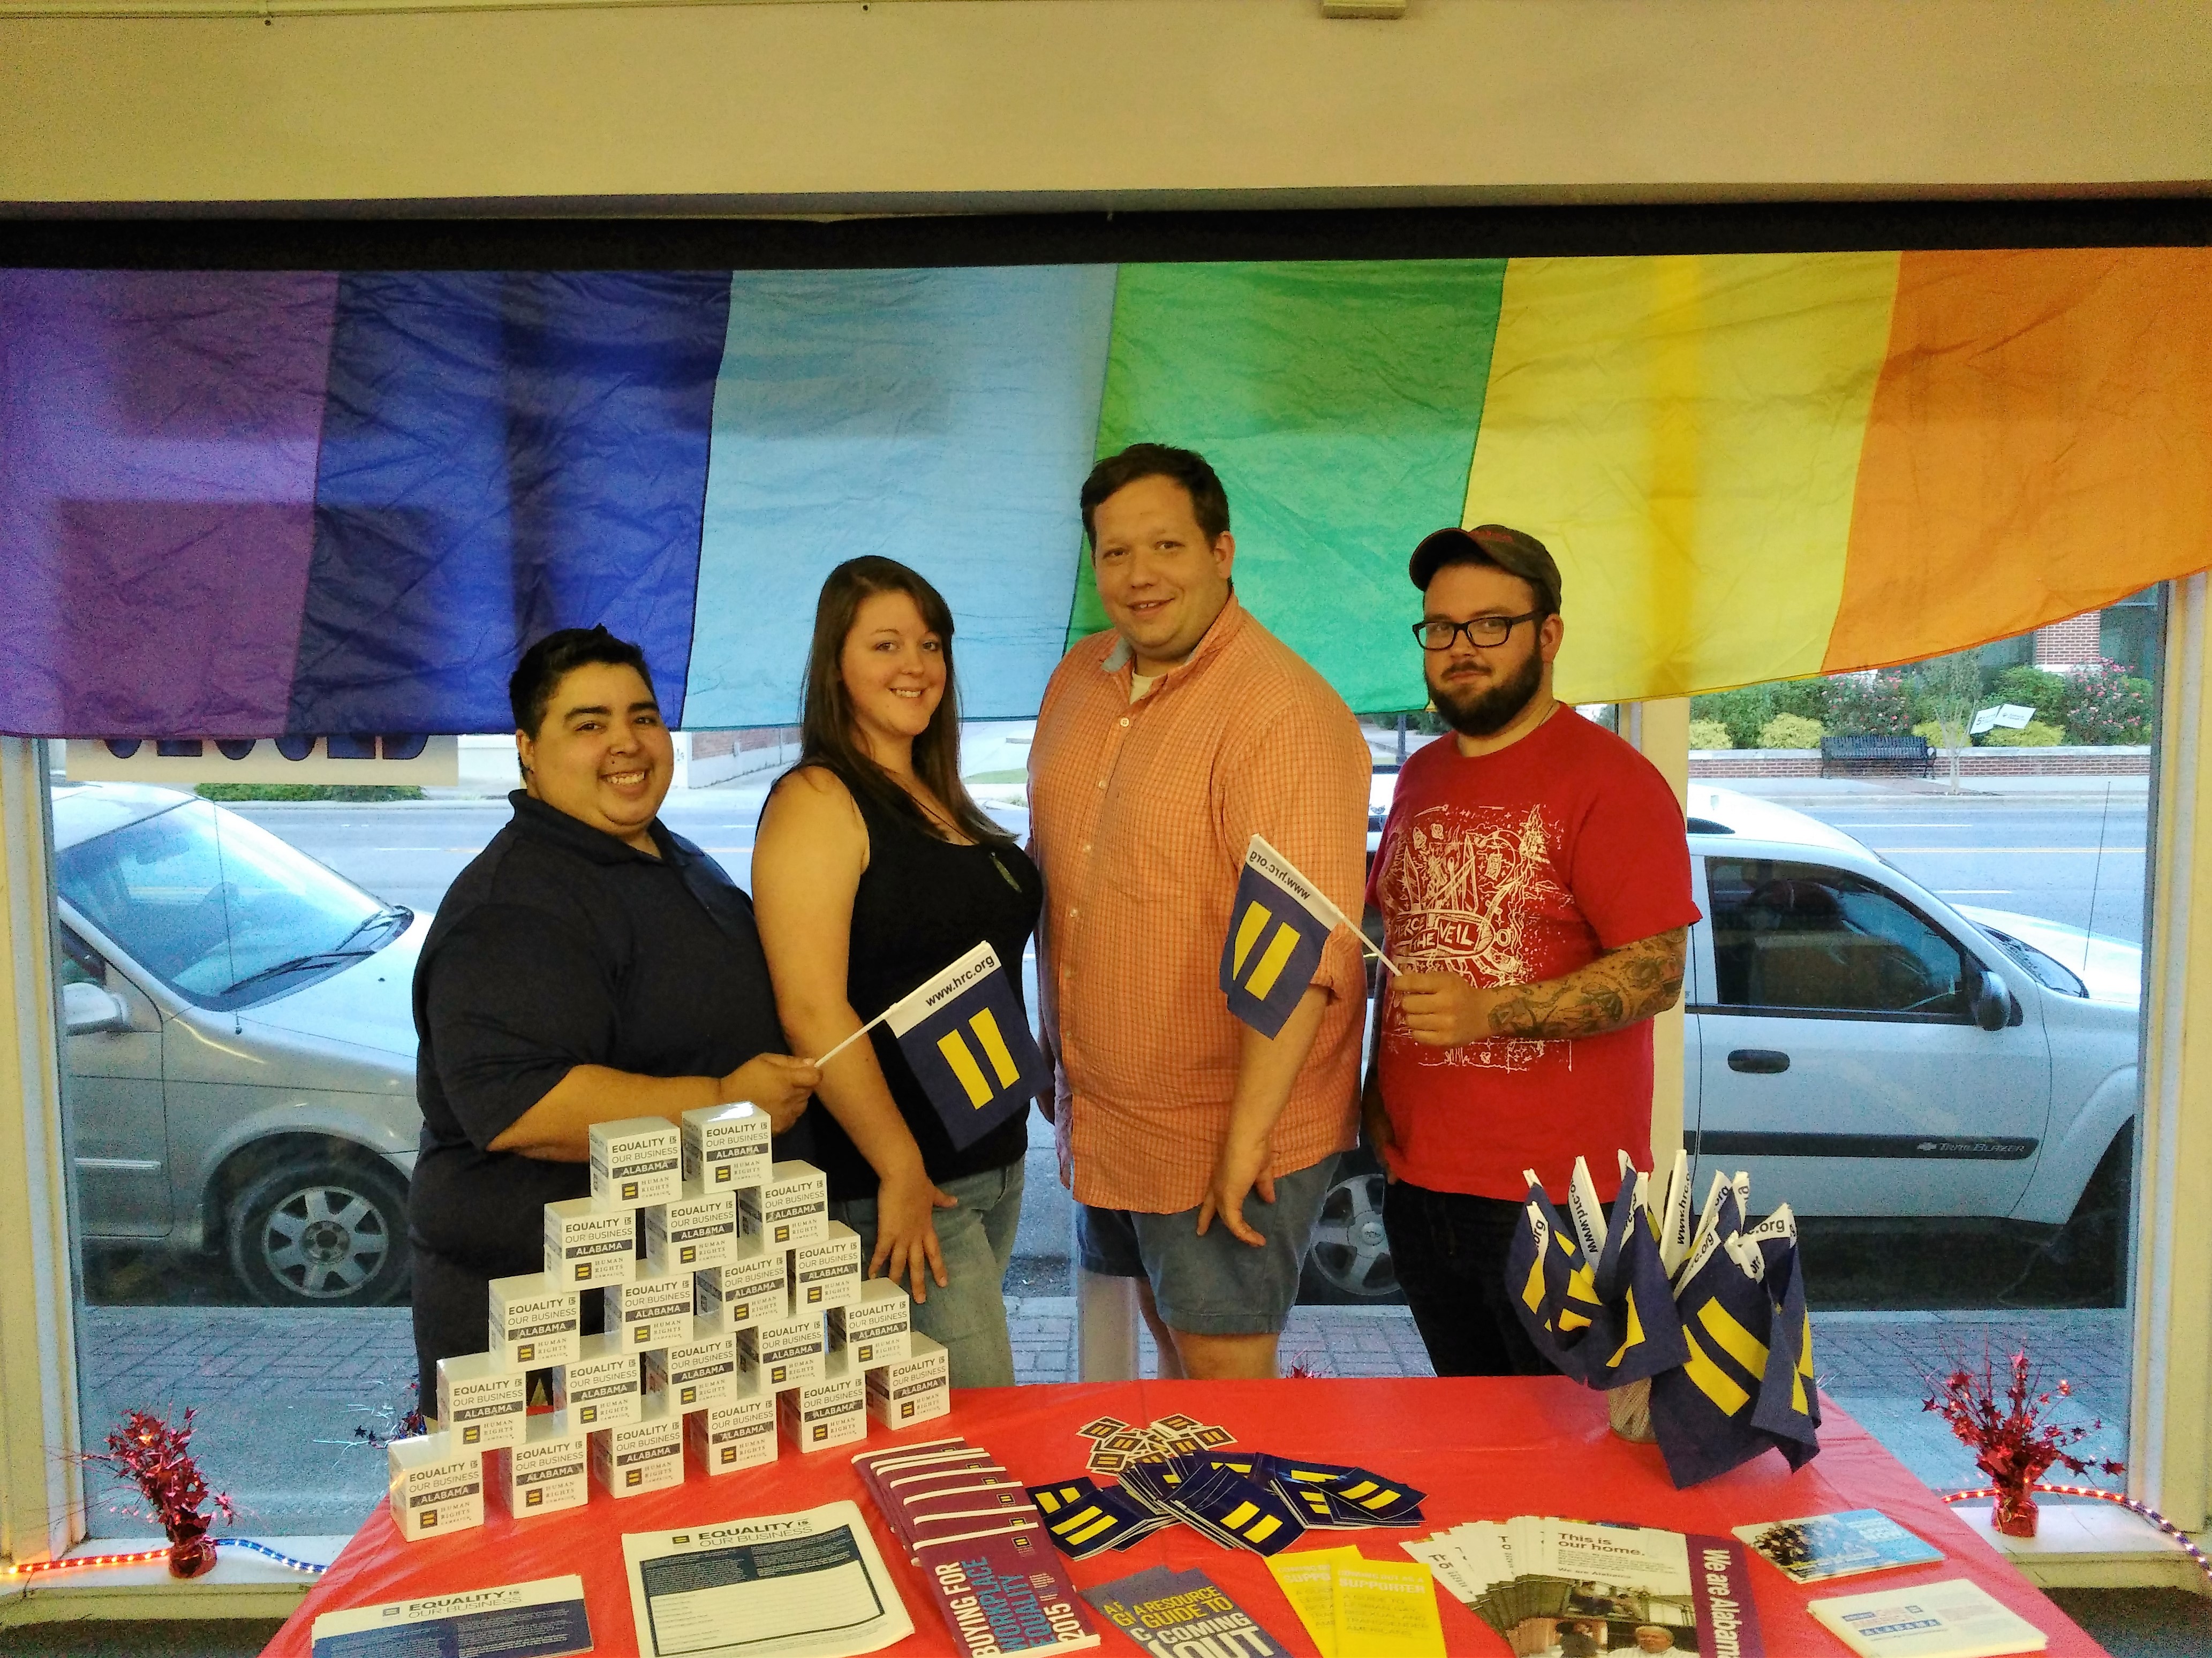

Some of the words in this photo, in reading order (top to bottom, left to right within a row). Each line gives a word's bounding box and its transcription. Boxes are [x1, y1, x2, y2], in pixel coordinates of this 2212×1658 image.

[1413, 932, 1435, 950] THE
[1440, 921, 1474, 945] VEIL
[925, 956, 994, 1006] www.hrc.org
[706, 1123, 756, 1137] EQUALITY
[760, 1121, 767, 1130] IS
[612, 1137, 665, 1153] EQUALITY
[669, 1135, 677, 1144] IS
[706, 1138, 724, 1147] OUR
[728, 1132, 768, 1144] BUSINESS
[611, 1154, 631, 1164] OUR
[635, 1146, 678, 1160] BUSINESS
[716, 1145, 759, 1159] ALABAMA
[622, 1161, 668, 1175] ALABAMA
[765, 1182, 812, 1199] EQUALITY
[765, 1198, 783, 1208] OUR
[786, 1190, 824, 1205] BUSINESS
[671, 1202, 721, 1218] EQUALITY
[726, 1200, 733, 1209] IS
[775, 1203, 816, 1219] ALABAMA
[565, 1217, 619, 1233] EQUALITY
[624, 1216, 631, 1225] IS
[670, 1218, 690, 1228] OUR
[692, 1210, 733, 1224] BUSINESS
[565, 1234, 585, 1244] OUR
[588, 1227, 632, 1240] BUSINESS
[681, 1224, 724, 1239] ALABAMA
[576, 1241, 623, 1255] ALABAMA
[799, 1243, 846, 1259] EQUALITY
[595, 1257, 623, 1266] HUMAN
[595, 1264, 623, 1273] RIGHTS
[724, 1259, 772, 1277] EQUALITY
[799, 1259, 817, 1269] OUR
[819, 1251, 858, 1265] BUSINESS
[724, 1277, 743, 1288] OUR
[745, 1266, 784, 1283] BUSINESS
[808, 1265, 849, 1280] ALABAMA
[625, 1281, 677, 1297] EQUALITY
[682, 1280, 689, 1288] IS
[735, 1281, 776, 1298] ALABAMA
[509, 1298, 563, 1315] EQUALITY
[568, 1296, 576, 1305] IS
[625, 1297, 644, 1307] OUR
[647, 1290, 690, 1304] BUSINESS
[508, 1315, 529, 1326] OUR
[532, 1307, 576, 1322] BUSINESS
[635, 1304, 681, 1319] ALABAMA
[849, 1303, 895, 1320] EQUALITY
[849, 1319, 866, 1329] OUR
[869, 1310, 907, 1325] BUSINESS
[519, 1322, 567, 1337] ALABAMA
[762, 1322, 810, 1339] EQUALITY
[858, 1324, 899, 1339] ALABAMA
[762, 1339, 780, 1350] OUR
[782, 1330, 821, 1345] BUSINESS
[671, 1342, 721, 1360] EQUALITY
[671, 1359, 690, 1370] OUR
[692, 1350, 733, 1365] BUSINESS
[772, 1344, 813, 1360] ALABAMA
[570, 1360, 623, 1378] EQUALITY
[681, 1364, 724, 1381] ALABAMA
[893, 1358, 935, 1377] EQUALITY
[893, 1376, 909, 1387] OUR
[911, 1365, 946, 1381] BUSINESS
[570, 1378, 590, 1388] OUR
[593, 1369, 637, 1384] BUSINESS
[901, 1379, 938, 1396] ALABAMA
[454, 1380, 509, 1396] EQUALITY
[581, 1383, 627, 1399] ALABAMA
[804, 1380, 851, 1399] EQUALITY
[453, 1397, 474, 1407] OUR
[477, 1389, 523, 1403] BUSINESS
[804, 1398, 821, 1409] OUR
[824, 1388, 863, 1404] BUSINESS
[464, 1403, 512, 1419] ALABAMA
[712, 1402, 761, 1420] EQUALITY
[813, 1402, 855, 1418] ALABAMA
[712, 1419, 730, 1430] OUR
[733, 1410, 773, 1425] BUSINESS
[616, 1423, 667, 1442] EQUALITY
[722, 1424, 765, 1440] ALABAMA
[616, 1441, 635, 1452] OUR
[638, 1432, 680, 1447] BUSINESS
[516, 1442, 570, 1461] EQUALITY
[626, 1446, 671, 1463] ALABAMA
[516, 1460, 536, 1471] OUR
[539, 1451, 583, 1466] BUSINESS
[409, 1462, 465, 1482] EQUALITY
[526, 1465, 573, 1482] ALABAMA
[409, 1481, 430, 1493] OUR
[433, 1470, 479, 1488] BUSINESS
[420, 1486, 469, 1504] ALABAMA
[699, 1521, 794, 1540] EQUALITY
[700, 1536, 734, 1547] OUR
[737, 1526, 812, 1542] BUSINESS
[1558, 1533, 1593, 1543] This
[1558, 1541, 1587, 1549] our
[1591, 1543, 1645, 1556] home.
[1703, 1549, 1732, 1572] We
[935, 1562, 971, 1596] FOR
[1339, 1578, 1425, 1594] SUPPORTER
[1705, 1573, 1731, 1596] are
[409, 1609, 442, 1618] OUR
[447, 1596, 522, 1613] BUSINESS
[410, 1591, 505, 1611] EQUALITY
[961, 1556, 1029, 1653] WORKPLACE
[1133, 1605, 1145, 1615] A
[1143, 1585, 1221, 1612] RESOURCE
[998, 1574, 1058, 1648] EQUALITY
[1141, 1603, 1207, 1629] GUIDE
[1201, 1596, 1234, 1613] TO
[950, 1595, 1001, 1658] BUYING
[1043, 1602, 1086, 1642] 2015
[1157, 1612, 1252, 1644] COMING
[1710, 1596, 1743, 1658] Alabam
[1173, 1625, 1274, 1658] OUT
